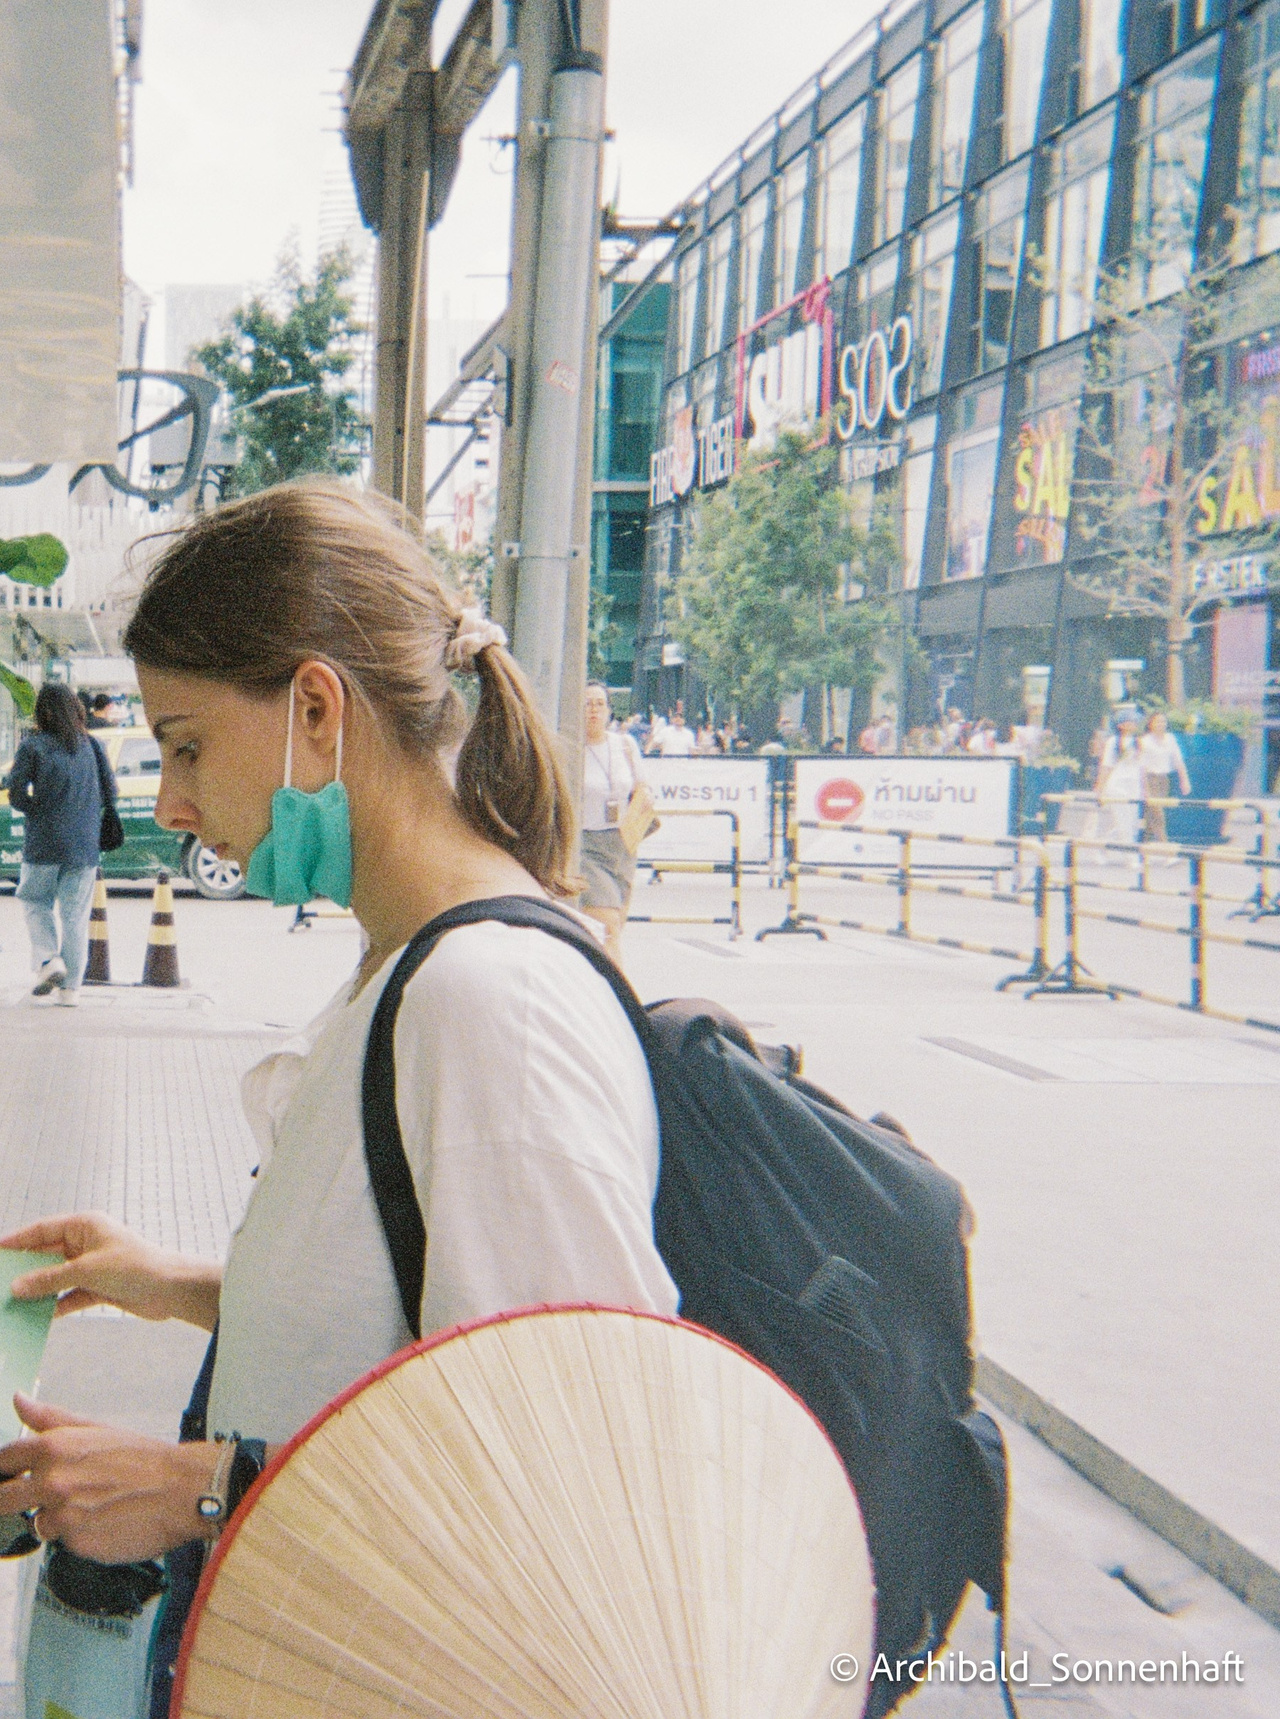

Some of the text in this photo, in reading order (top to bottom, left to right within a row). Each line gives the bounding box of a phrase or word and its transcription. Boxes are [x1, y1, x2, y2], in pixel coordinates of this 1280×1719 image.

[873, 777, 978, 804] ห้ามผ่าน
[873, 809, 934, 822] NO PASS
